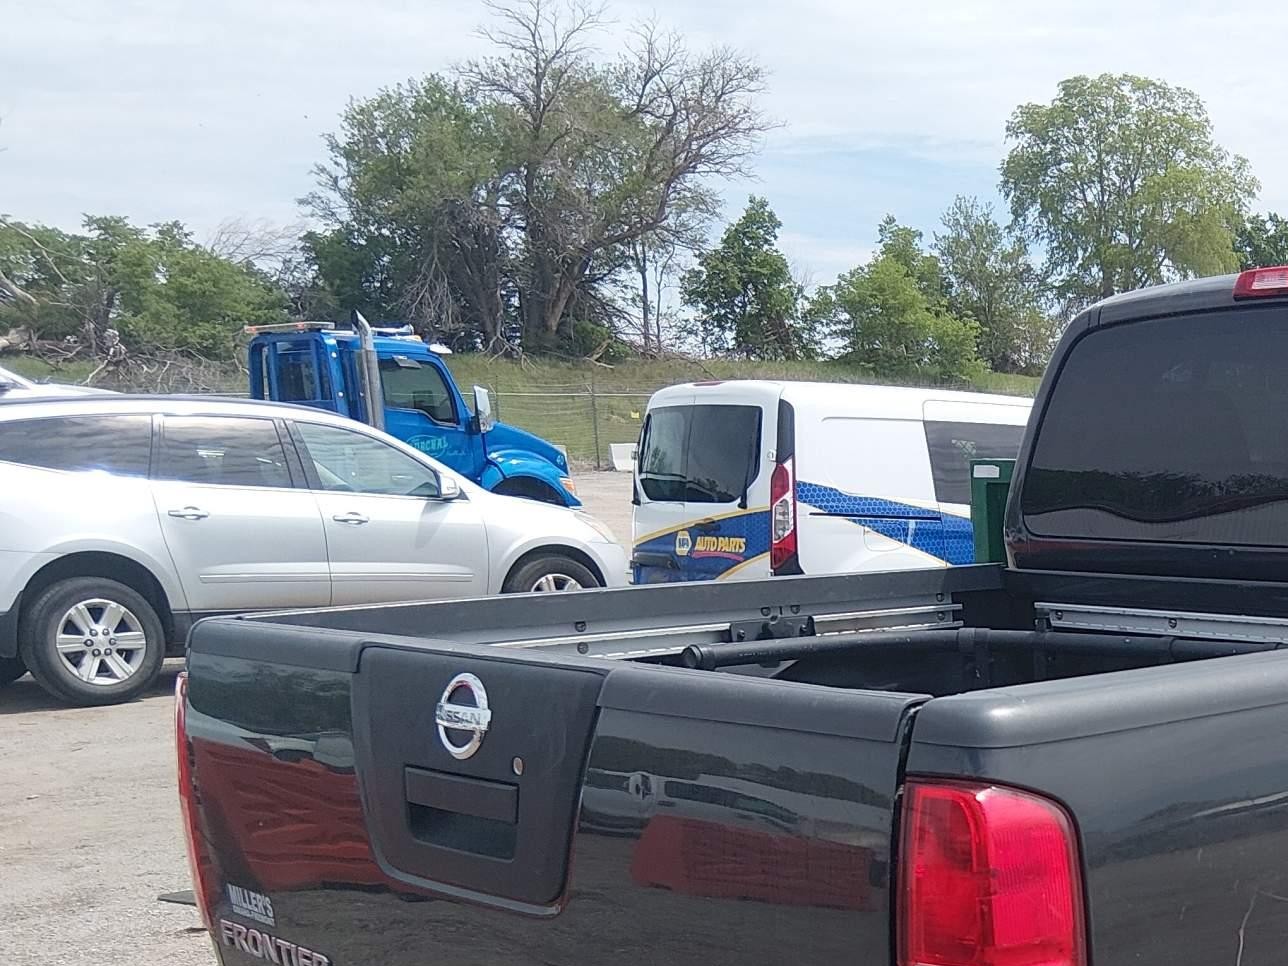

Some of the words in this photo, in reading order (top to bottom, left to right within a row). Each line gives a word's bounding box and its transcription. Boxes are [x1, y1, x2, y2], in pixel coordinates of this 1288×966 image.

[694, 536, 717, 551] AUTO
[717, 536, 746, 553] PARTS
[226, 883, 274, 918] MILLER'S
